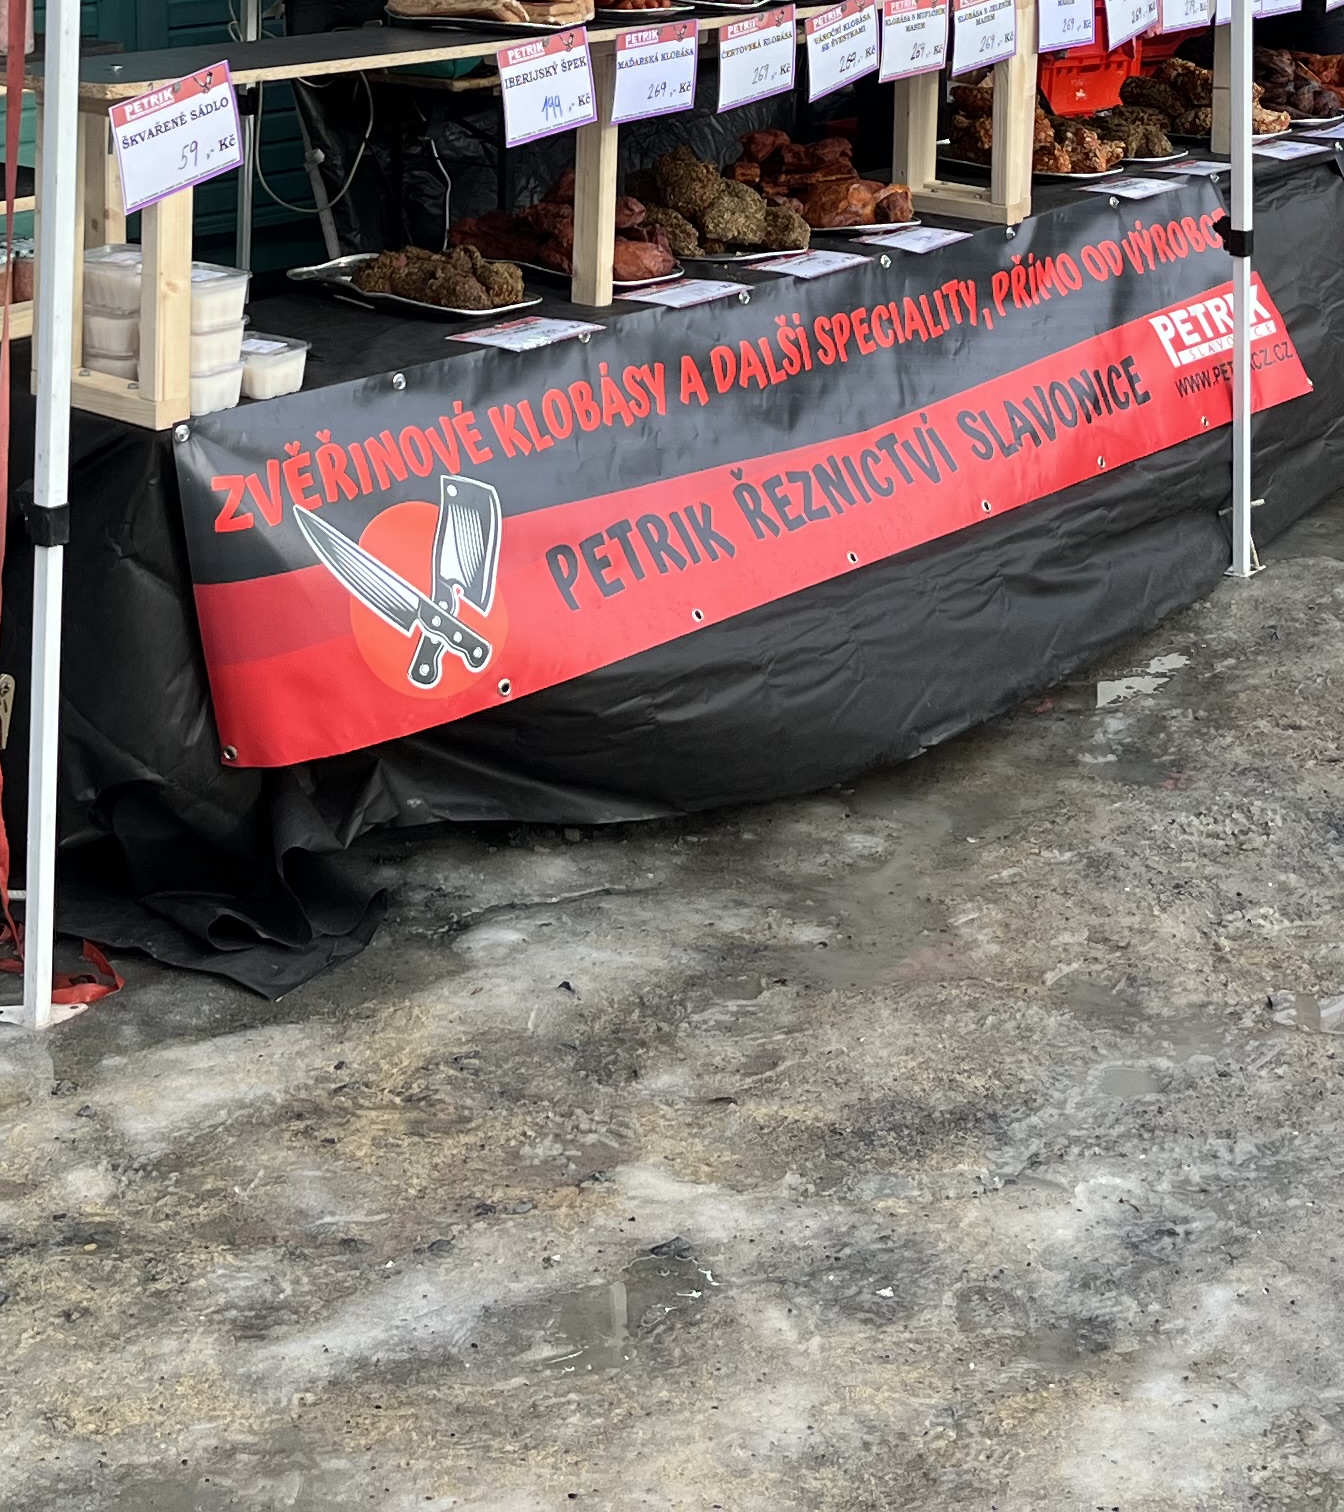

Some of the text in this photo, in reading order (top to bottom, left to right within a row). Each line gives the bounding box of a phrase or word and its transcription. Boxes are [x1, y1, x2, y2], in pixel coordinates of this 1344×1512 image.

[813, 5, 842, 31] PETRIK
[625, 29, 659, 48] PETRIK
[763, 30, 793, 47] KLOBÁSA
[507, 41, 546, 65] PETRIK
[660, 46, 694, 62] KLOBÁSA
[865, 45, 876, 58] Kč
[504, 55, 587, 90] IBERIJSKÝ ŠPEK
[779, 62, 792, 76] Kč
[577, 92, 591, 107] Kč
[647, 81, 667, 100] 269
[678, 80, 692, 93] Kč
[124, 87, 175, 121] PETRIK
[122, 96, 229, 149] ŠKVAŘENÉ SÁDLO
[177, 140, 199, 170] 59
[217, 134, 237, 152] Kč
[211, 207, 1227, 534] ZVĚŘINOVÉ KLOBÁSY A DALŠÍ SPECIALITY, PŘÍMO OD VÝROBC
[545, 355, 1153, 611] PETRIK ŘEZNICTVÍ SLAVONICE
